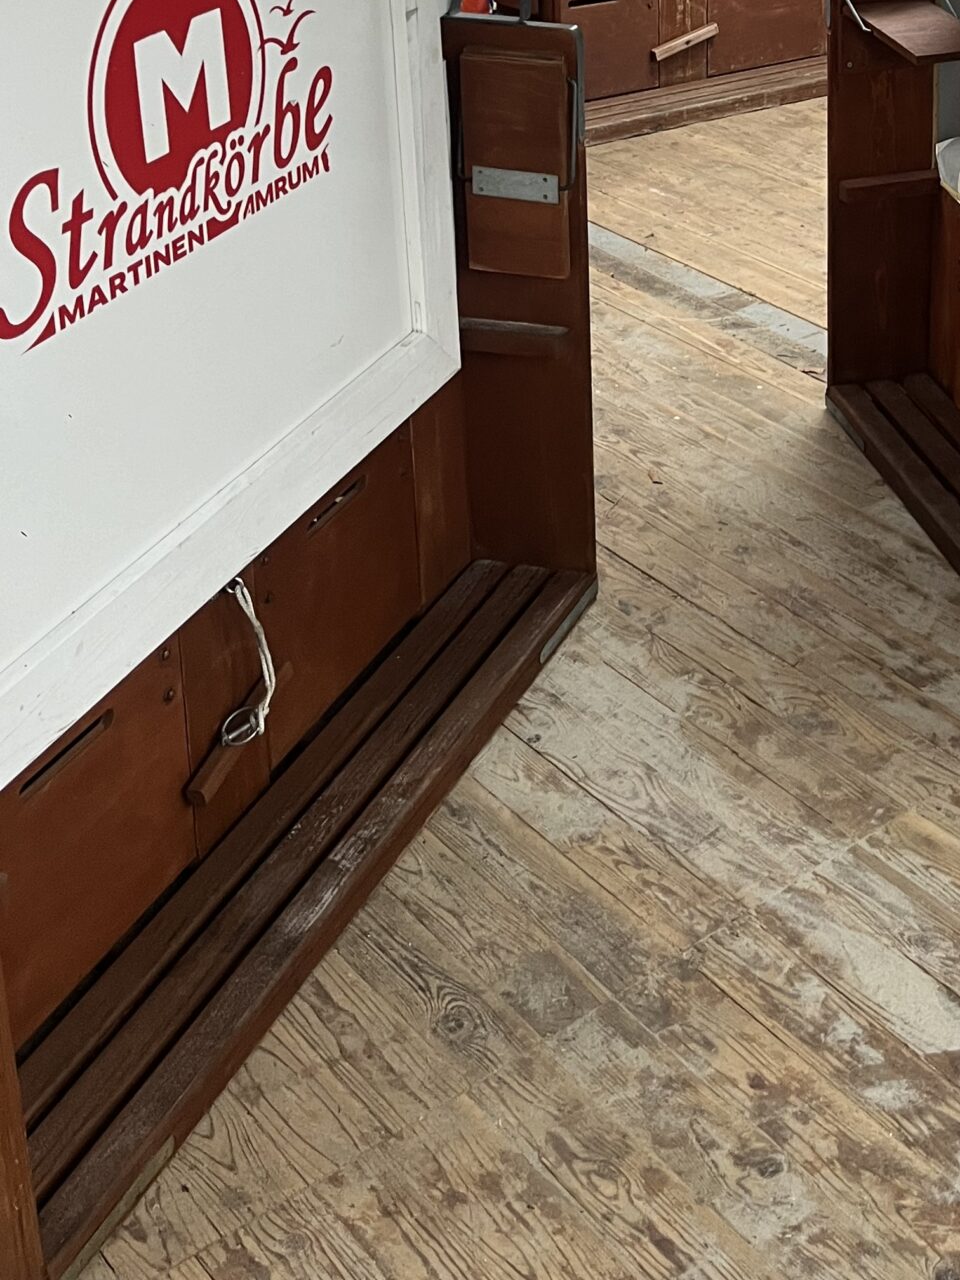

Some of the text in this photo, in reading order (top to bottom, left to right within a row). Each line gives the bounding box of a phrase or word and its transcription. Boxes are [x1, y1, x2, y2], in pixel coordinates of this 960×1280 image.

[133, 7, 231, 164] M
[0, 58, 333, 340] Strandkörbe
[58, 155, 321, 330] MARTINEN AMRUM
